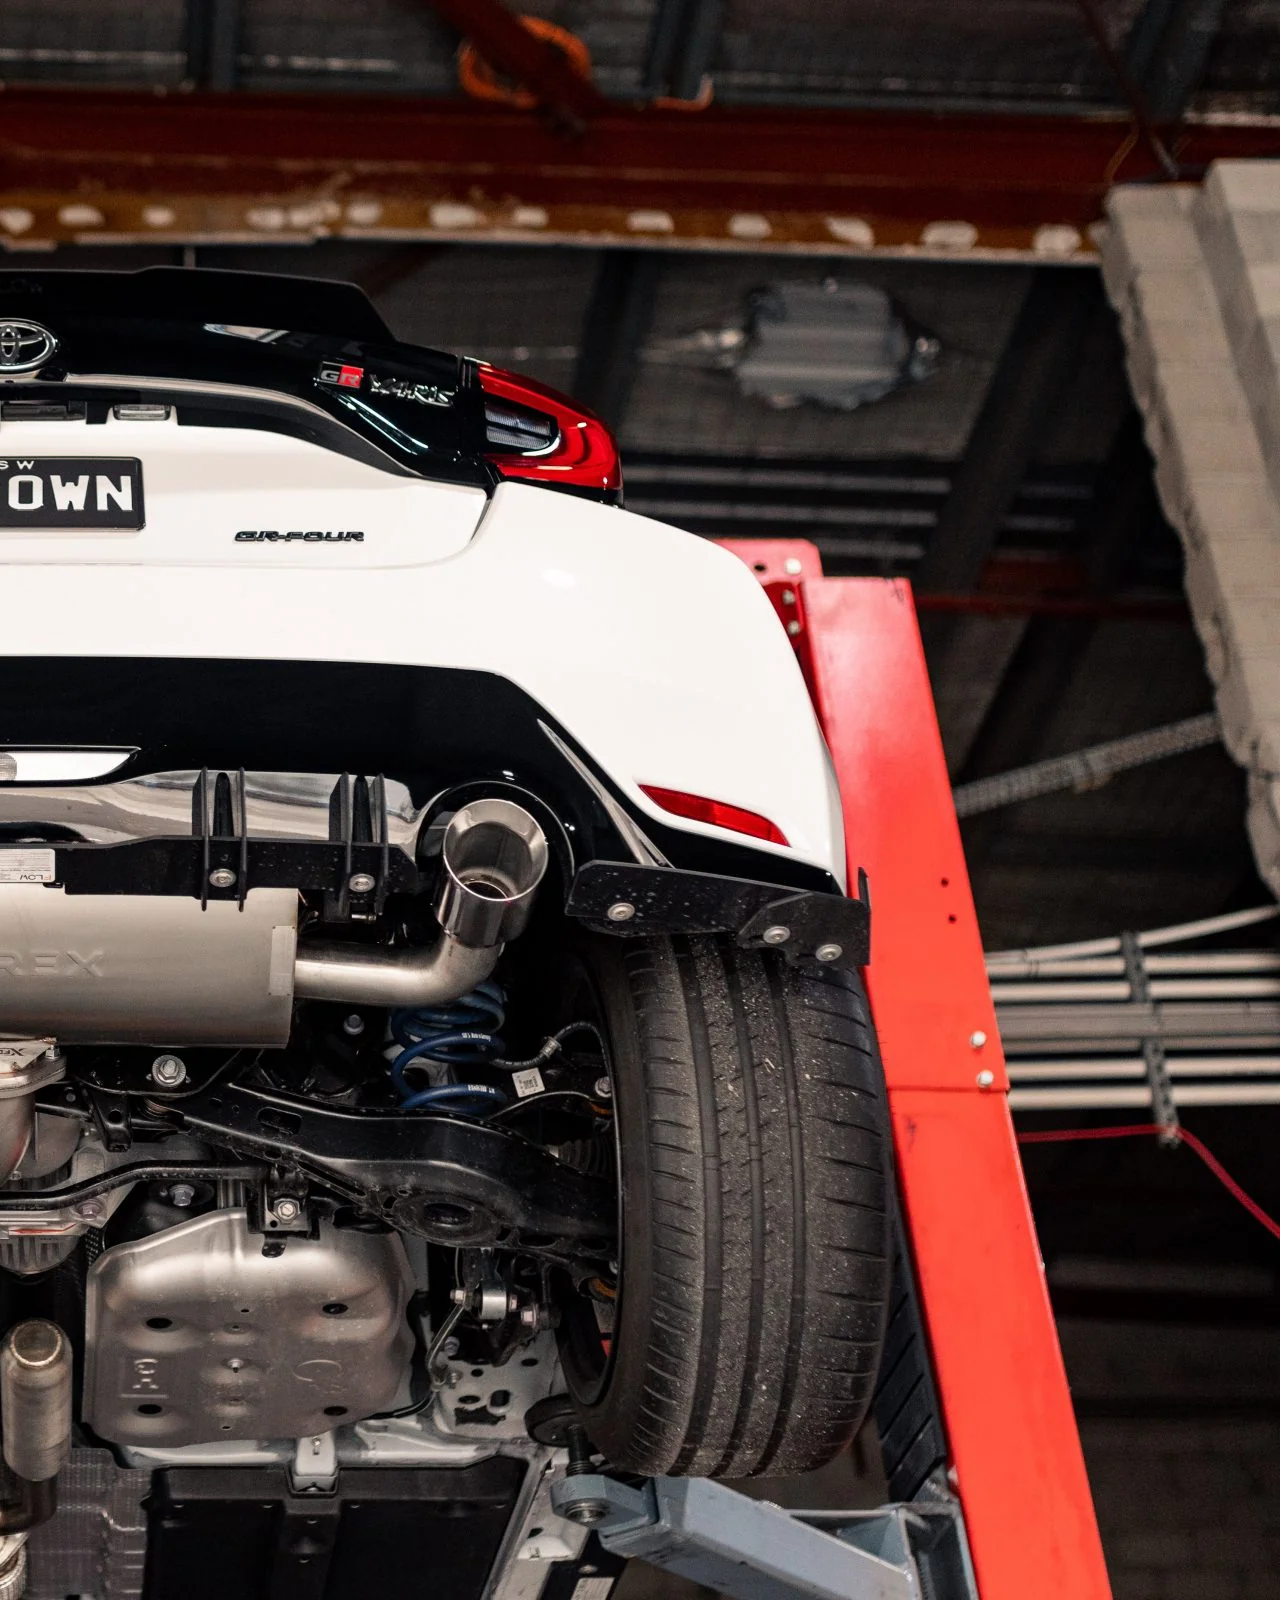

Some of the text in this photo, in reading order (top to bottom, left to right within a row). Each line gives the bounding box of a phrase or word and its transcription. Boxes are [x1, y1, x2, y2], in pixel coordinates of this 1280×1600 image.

[320, 370, 360, 387] GR
[234, 530, 365, 543] GR-FOUR
[19, 873, 52, 881] FLOW
